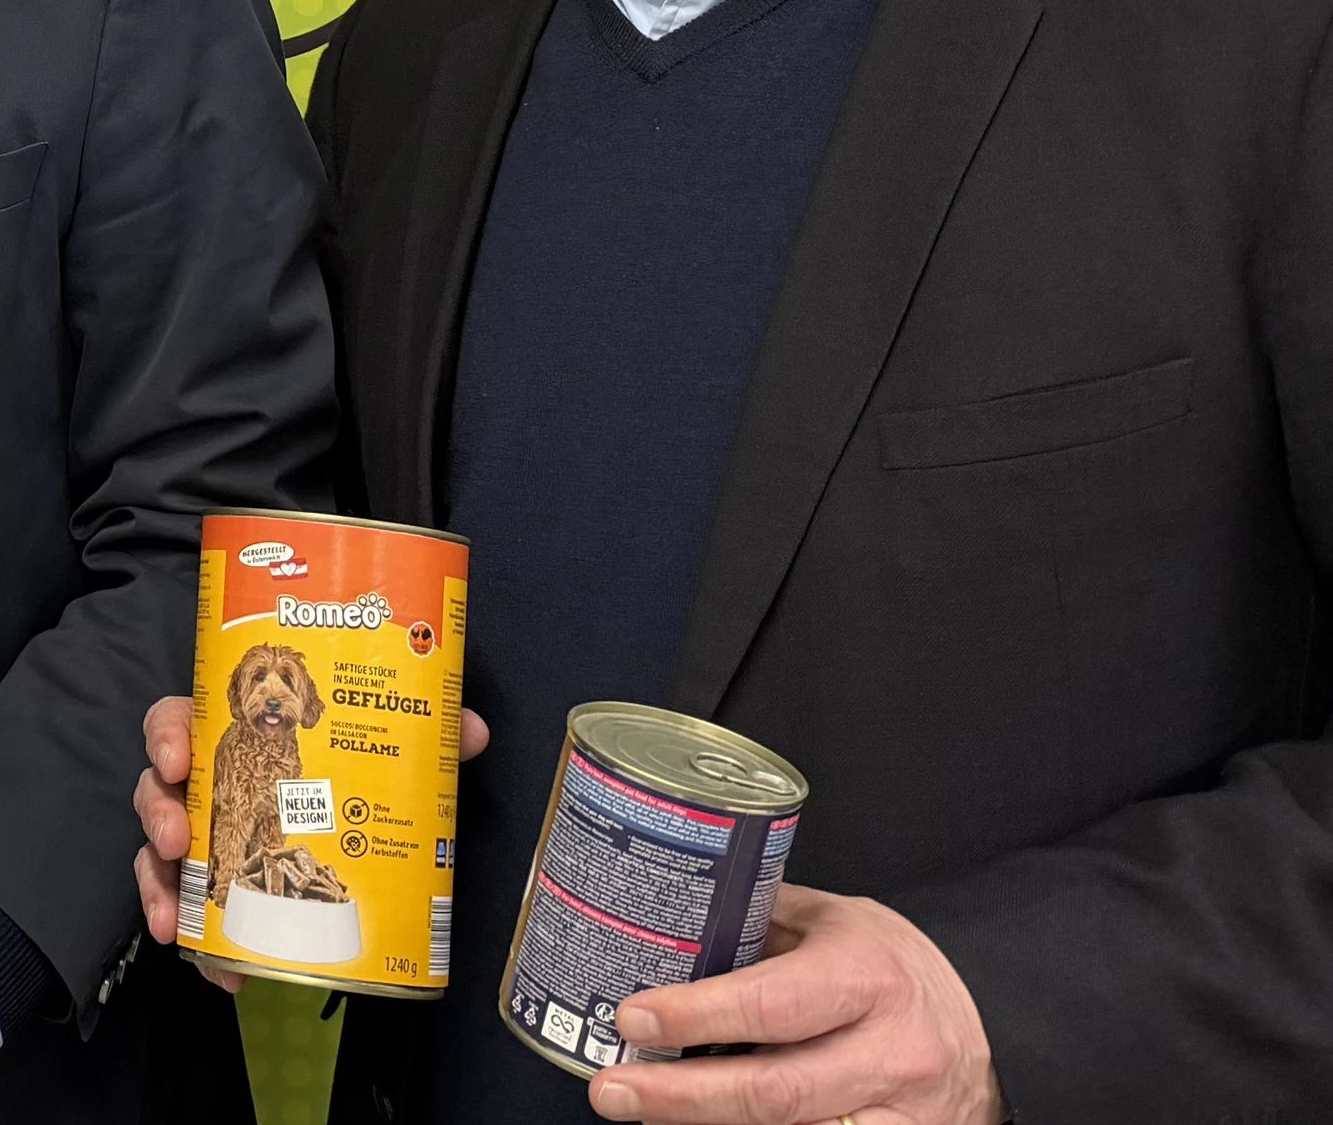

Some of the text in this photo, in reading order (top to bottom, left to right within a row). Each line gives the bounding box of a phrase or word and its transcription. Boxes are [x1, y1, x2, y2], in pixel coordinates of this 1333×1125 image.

[242, 545, 287, 558] HERGESTELLT
[278, 595, 383, 629] Romeo
[334, 662, 397, 679] SAFTIGE STÜCKE
[333, 674, 385, 689] IN SAUCE MIT
[332, 689, 431, 716] GEFLÜGEL
[330, 737, 400, 757] POLLAME
[286, 787, 323, 796] JETZT IM
[285, 797, 326, 811] NEUEN
[373, 803, 390, 813] Ohne
[287, 812, 328, 824] DESIGN!
[373, 816, 414, 827] Zuckerzusatz
[372, 836, 388, 846] Ohne
[389, 837, 409, 848] Zusatz
[371, 847, 408, 859] Farbstoffen
[385, 956, 417, 978] 1240 g
